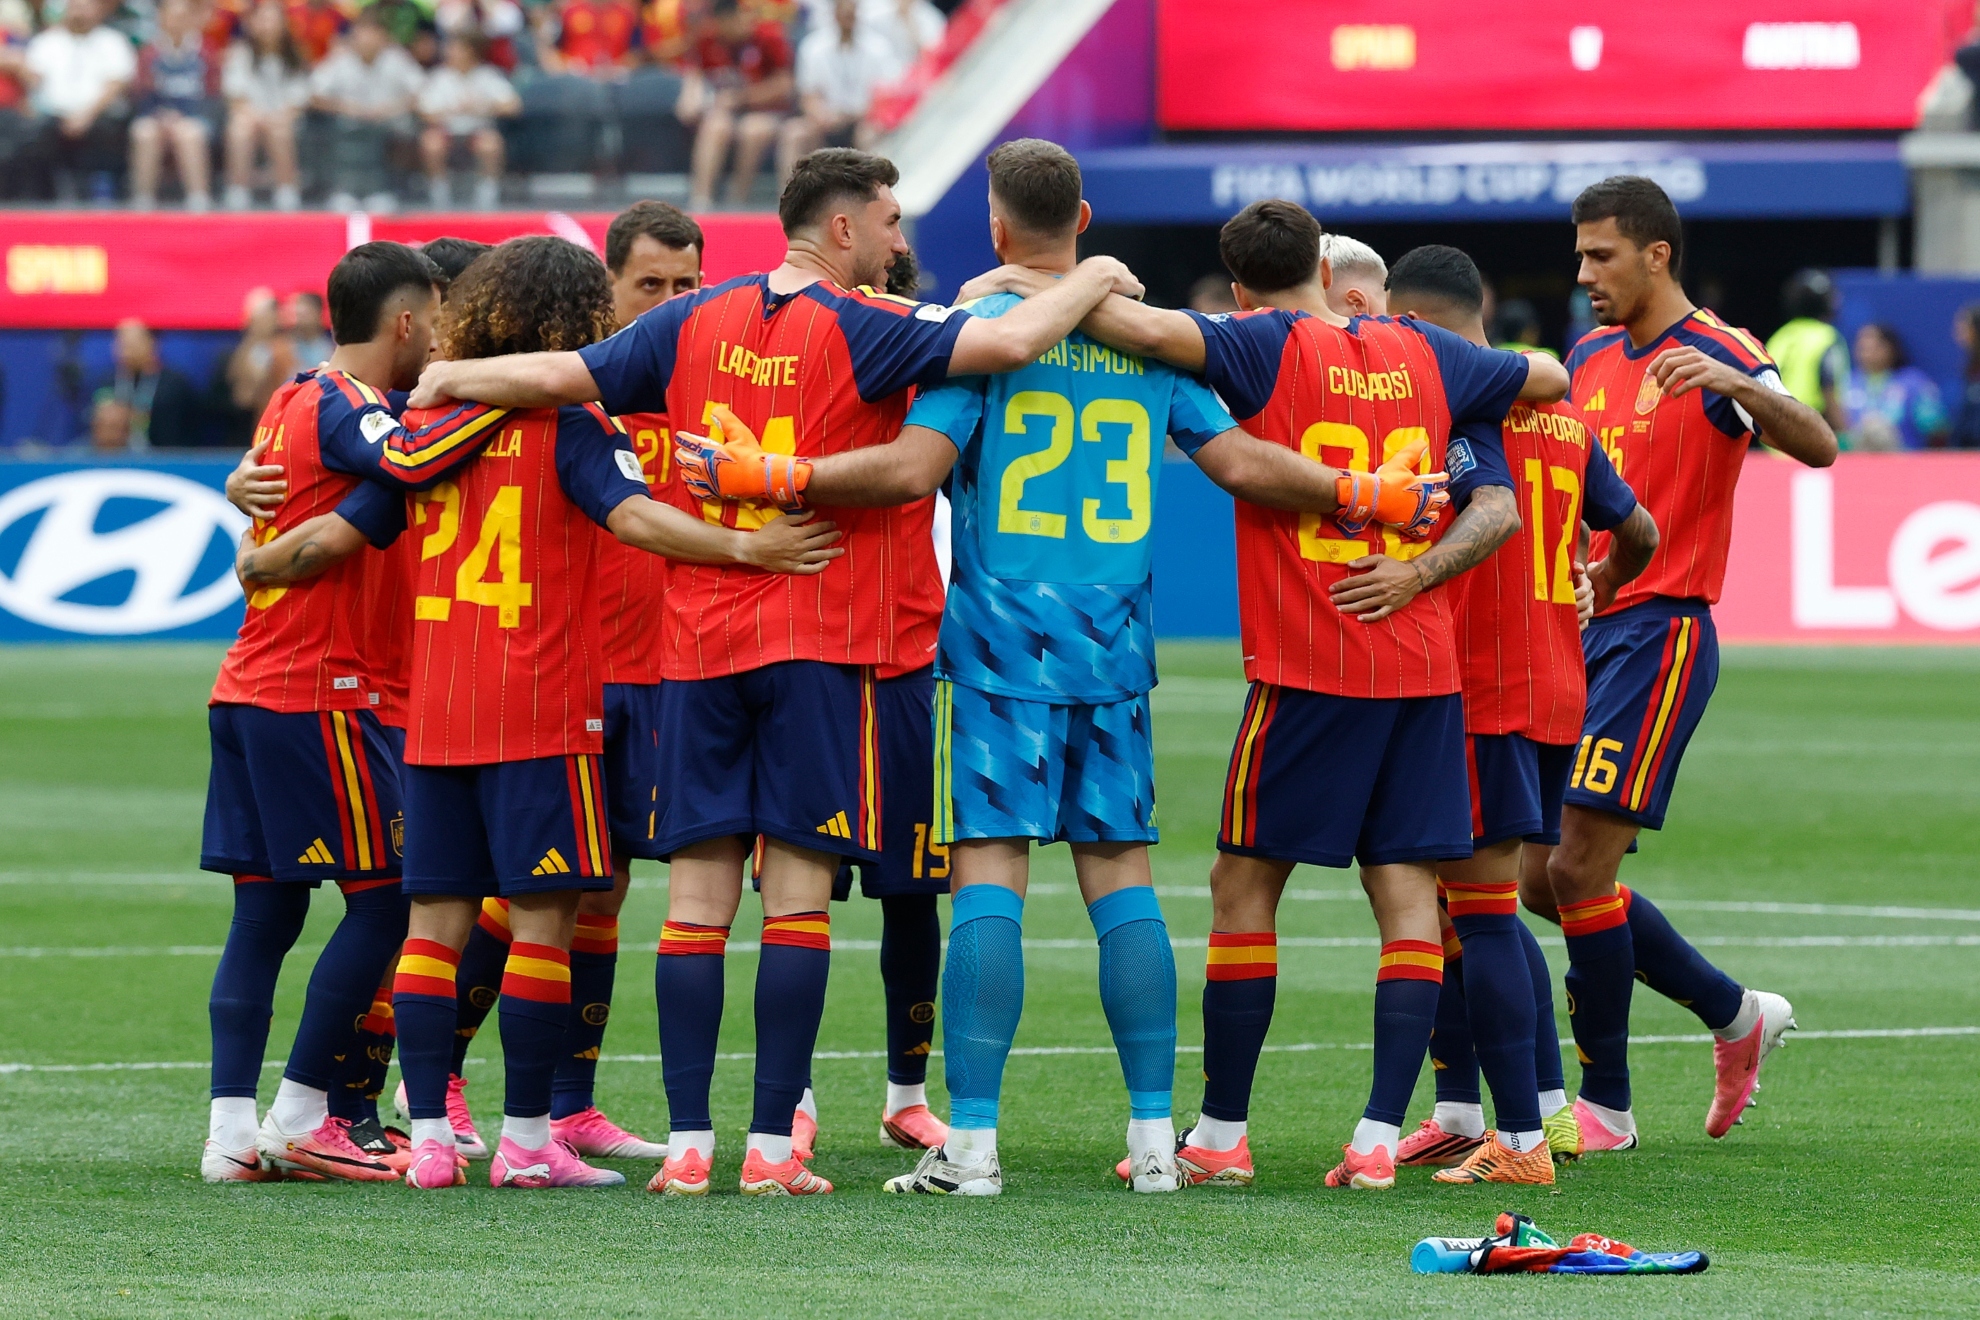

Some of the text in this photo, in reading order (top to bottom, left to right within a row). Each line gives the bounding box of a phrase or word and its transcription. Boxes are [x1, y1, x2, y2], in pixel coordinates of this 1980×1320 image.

[1211, 163, 1303, 206] FIFA
[1307, 163, 1460, 205] WORLD
[1464, 160, 1552, 204] CUP
[1328, 362, 1412, 401] CUBARSÍ
[636, 428, 671, 484] 21
[998, 390, 1151, 543] 23
[415, 481, 532, 628] 24
[1570, 735, 1624, 794] 16
